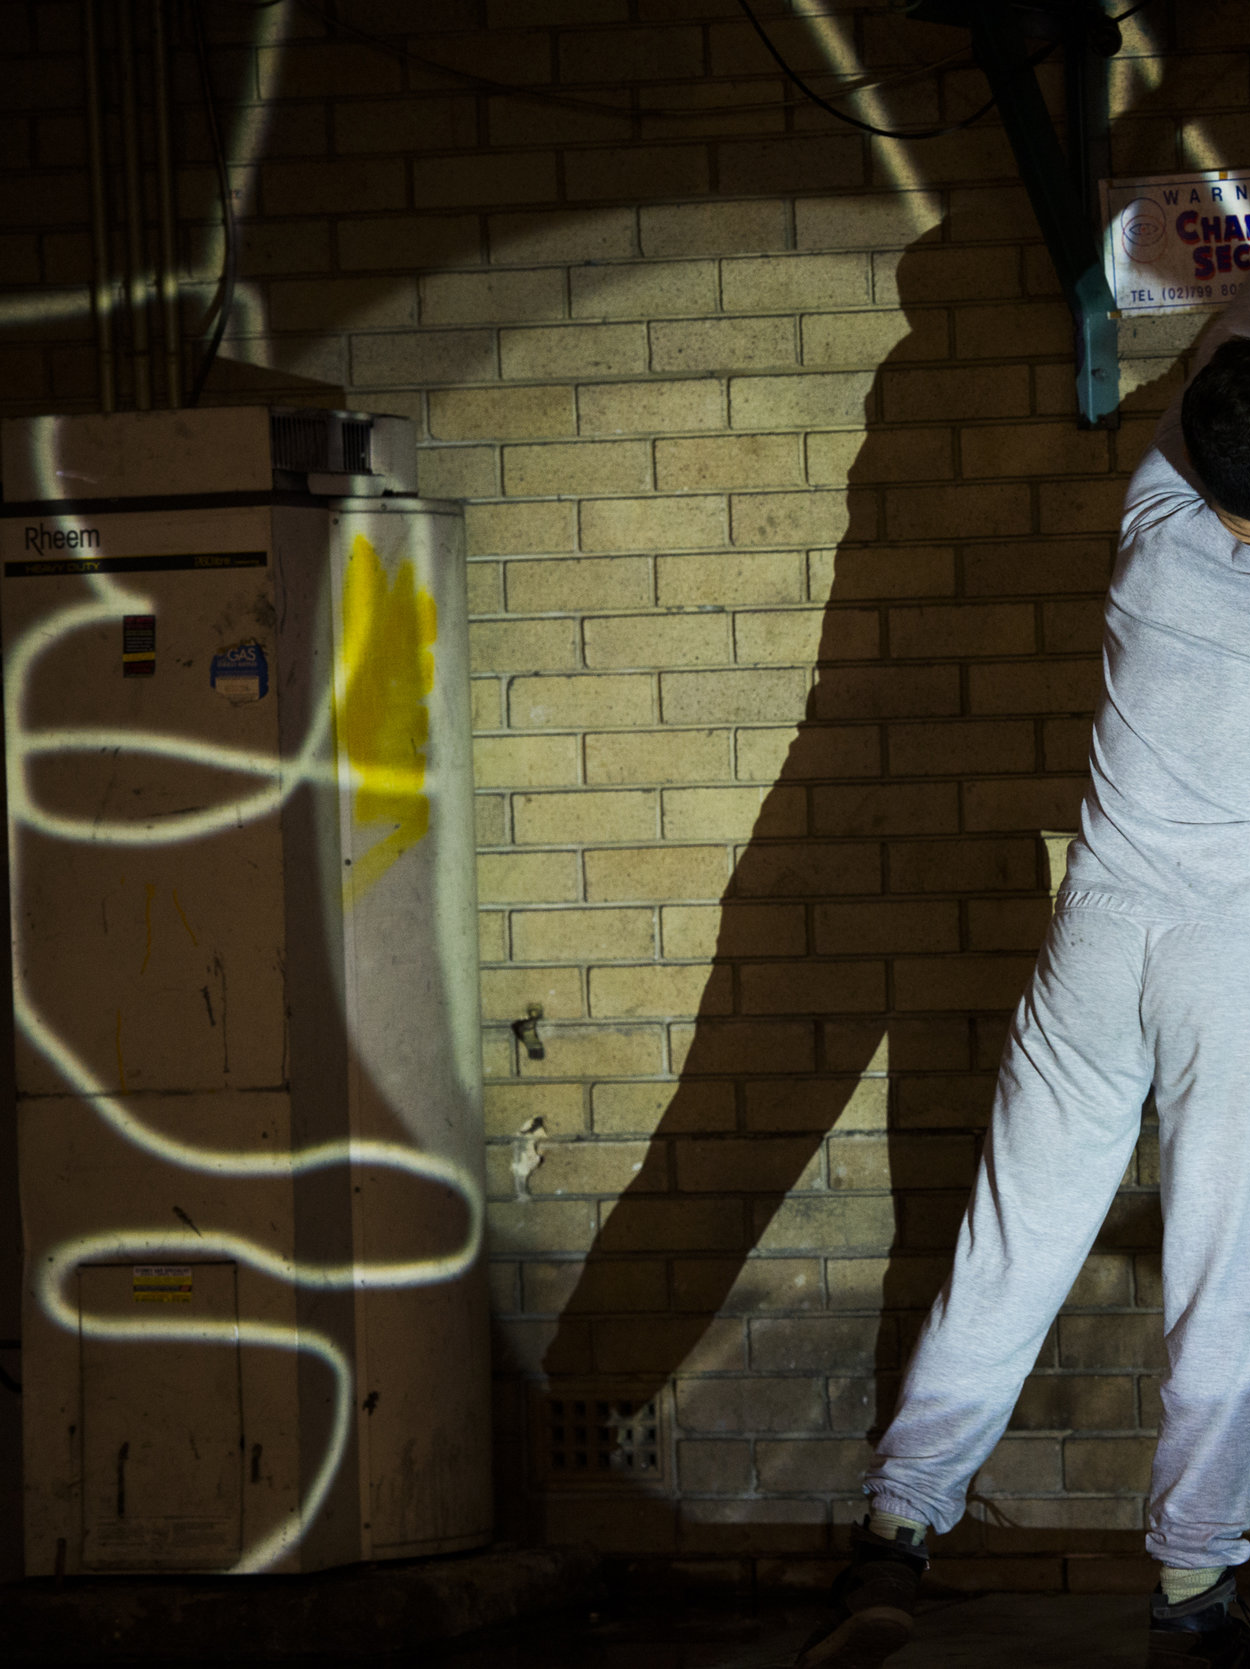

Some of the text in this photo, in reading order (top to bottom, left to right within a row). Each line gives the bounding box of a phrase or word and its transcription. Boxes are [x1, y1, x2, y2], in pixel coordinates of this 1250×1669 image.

[1130, 289, 1154, 302] TEL
[25, 523, 100, 556] Rheem
[226, 648, 256, 662] GAS
